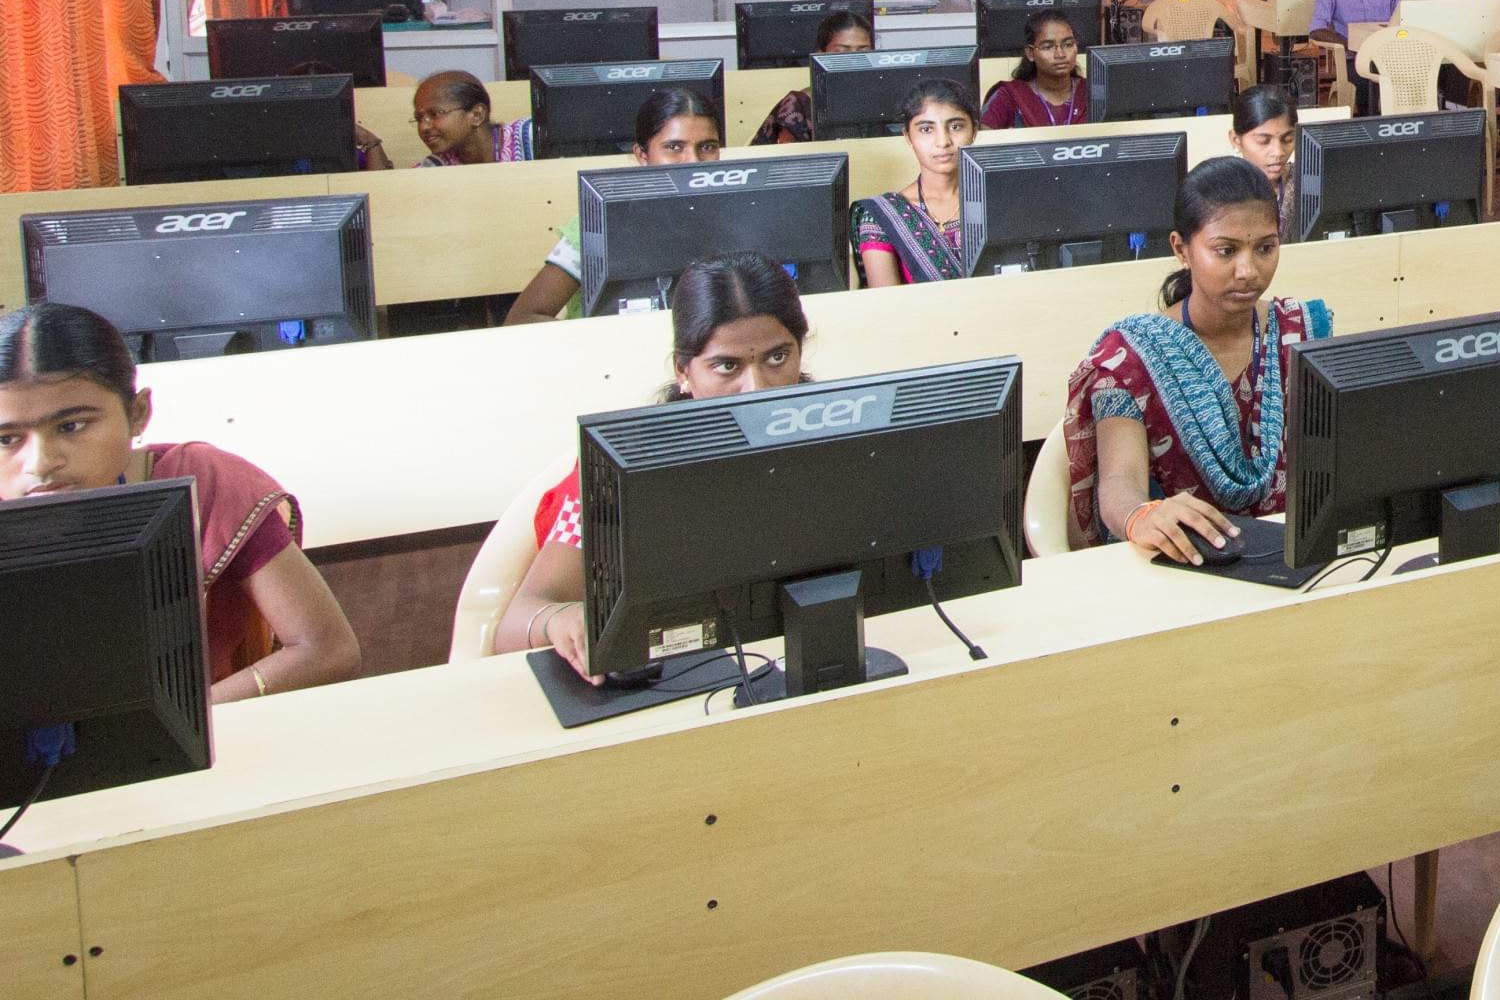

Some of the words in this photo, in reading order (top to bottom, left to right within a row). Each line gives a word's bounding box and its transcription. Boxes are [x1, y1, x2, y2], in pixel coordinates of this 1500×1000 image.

[790, 1, 825, 12] acer
[563, 11, 602, 21] acer
[273, 20, 319, 31] acer
[1150, 44, 1186, 57] acer
[878, 52, 922, 65] acer
[607, 66, 656, 80] acer
[211, 84, 271, 98] acer
[1378, 120, 1424, 137] acer
[1052, 143, 1110, 161] acer
[688, 168, 758, 188] acer
[155, 210, 247, 233] acer
[766, 394, 877, 436] acer
